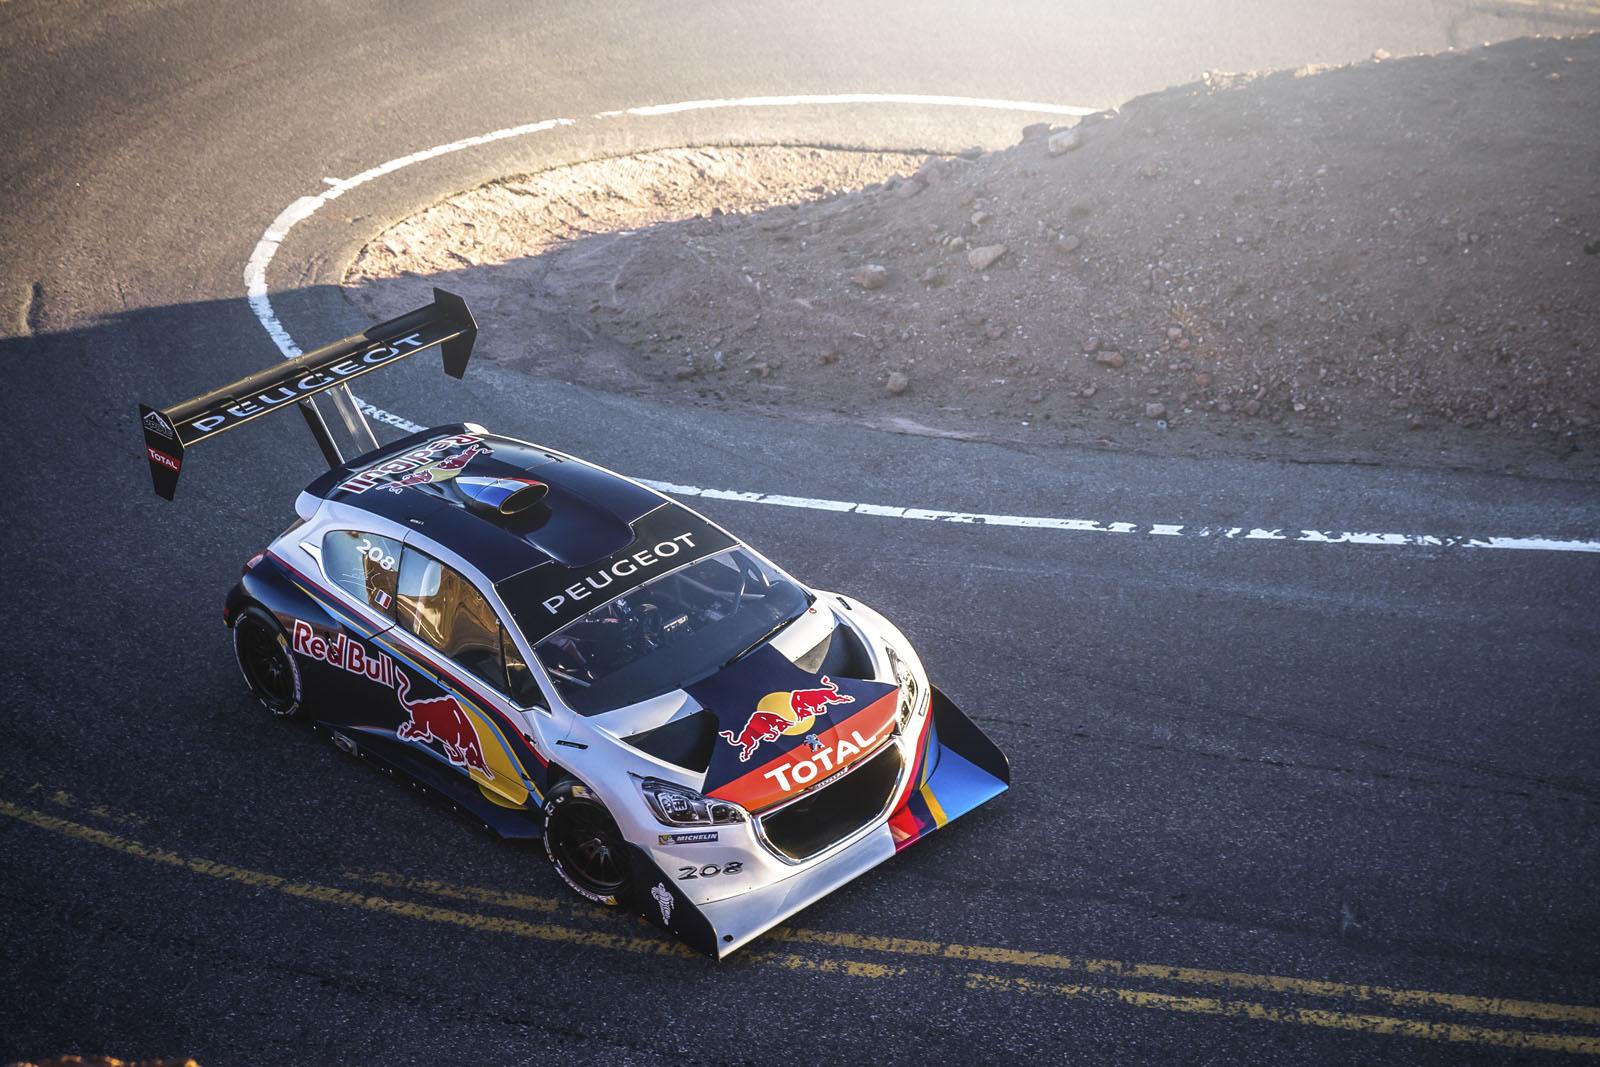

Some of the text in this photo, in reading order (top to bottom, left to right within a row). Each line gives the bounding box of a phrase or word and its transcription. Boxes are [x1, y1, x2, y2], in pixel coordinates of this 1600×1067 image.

[192, 333, 425, 433] PEUGEOT
[148, 448, 178, 470] TOTAL
[356, 538, 395, 571] 208
[542, 532, 697, 615] PEUGEOT
[764, 729, 878, 792] TOTAL
[676, 833, 718, 842] MICHELIN
[678, 861, 744, 881] 208
